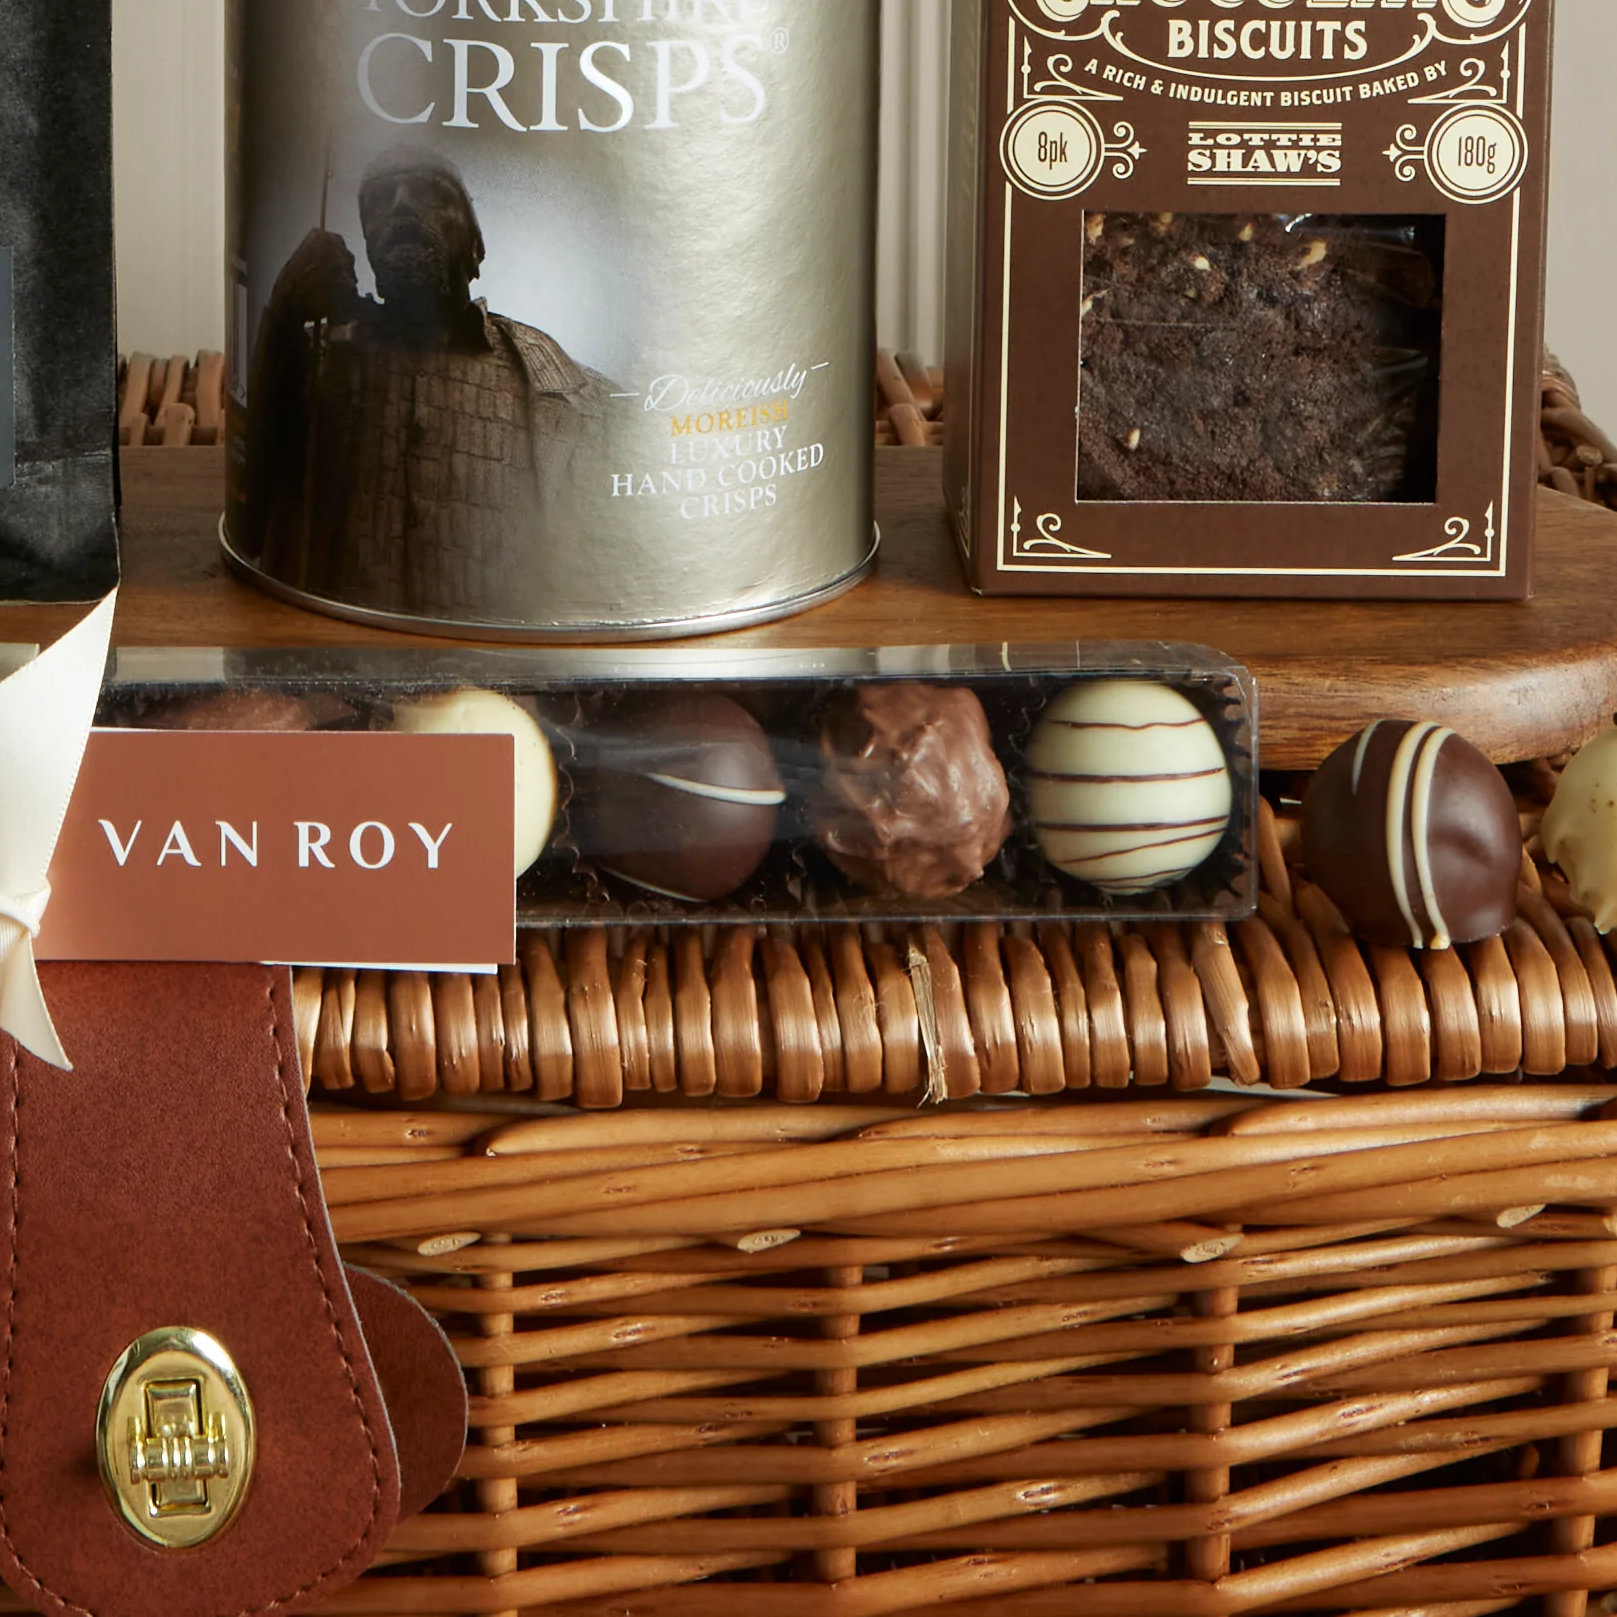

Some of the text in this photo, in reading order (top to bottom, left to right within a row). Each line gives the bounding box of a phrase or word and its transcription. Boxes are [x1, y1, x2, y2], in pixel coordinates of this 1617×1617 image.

[1168, 19, 1368, 60] BISCUITS
[1084, 59, 1448, 107] A RICH & INDULGENT BISCUIT BAKED BY
[1037, 130, 1069, 171] 8pk
[1187, 132, 1343, 147] LOTTIE
[1457, 134, 1498, 175] 180g
[1188, 149, 1342, 173] SHAW'S
[644, 362, 807, 412] Deliciously
[669, 399, 789, 437] MOREISH
[670, 425, 787, 465] LUXURY
[610, 443, 824, 498] HAND COOKED
[680, 484, 777, 520] CRISPS
[97, 819, 453, 870] VAN ROY
